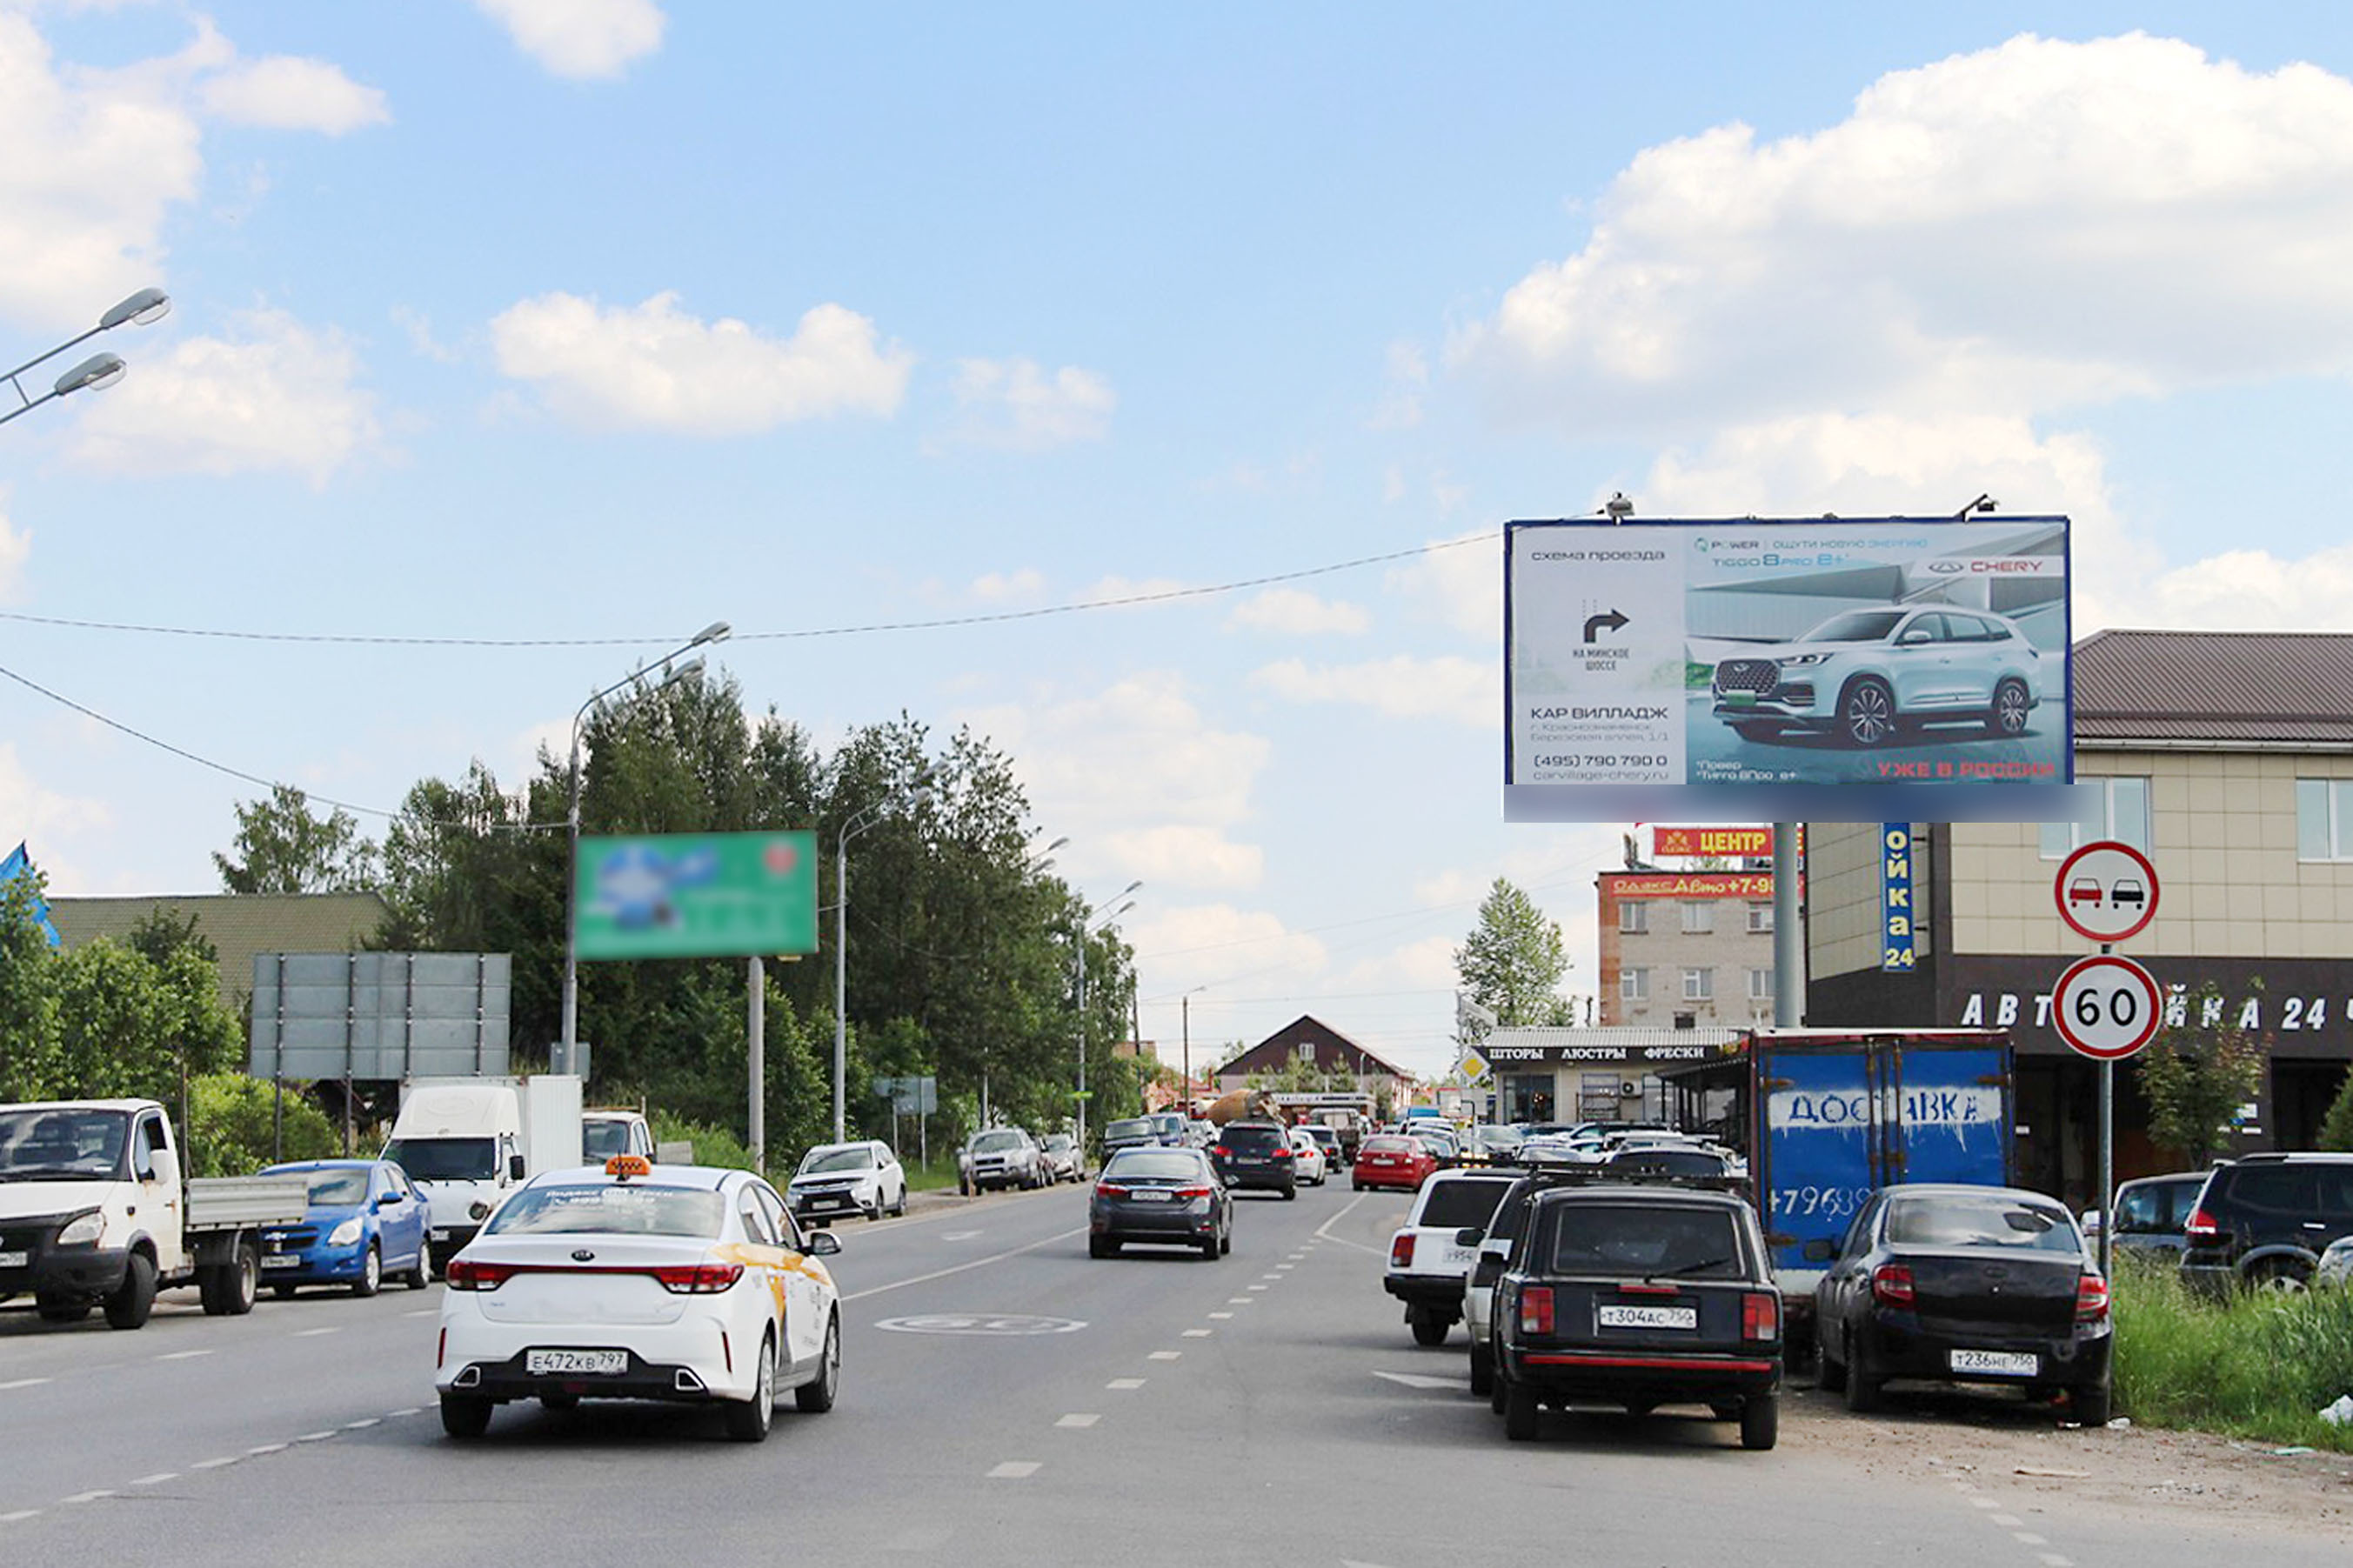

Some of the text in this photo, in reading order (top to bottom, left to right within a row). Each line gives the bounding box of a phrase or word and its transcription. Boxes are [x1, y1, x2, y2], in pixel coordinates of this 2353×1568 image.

[1531, 550, 1665, 562] схема проезда
[1970, 560, 2043, 572] CHERY
[1587, 648, 1629, 659] МИНСКОЕ
[1586, 660, 1617, 671] ШОССЕ
[1531, 707, 1668, 720] КАР ВИЛЛАДЖ
[1534, 754, 1668, 768] (495) 790 790 0
[1877, 762, 2056, 778] УЖЕ В РОССИИ
[1700, 831, 1767, 854] ЦЕНТР
[1885, 948, 1915, 967] 24
[2076, 988, 2137, 1027] 60
[2281, 997, 2327, 1031] 24
[1488, 1047, 1544, 1060] ШТОРЫ
[1561, 1047, 1627, 1060] ЛЮСТРЫ
[1643, 1046, 1705, 1059] ФРЕСКИ
[1788, 1091, 1978, 1124] ДОСАВКА
